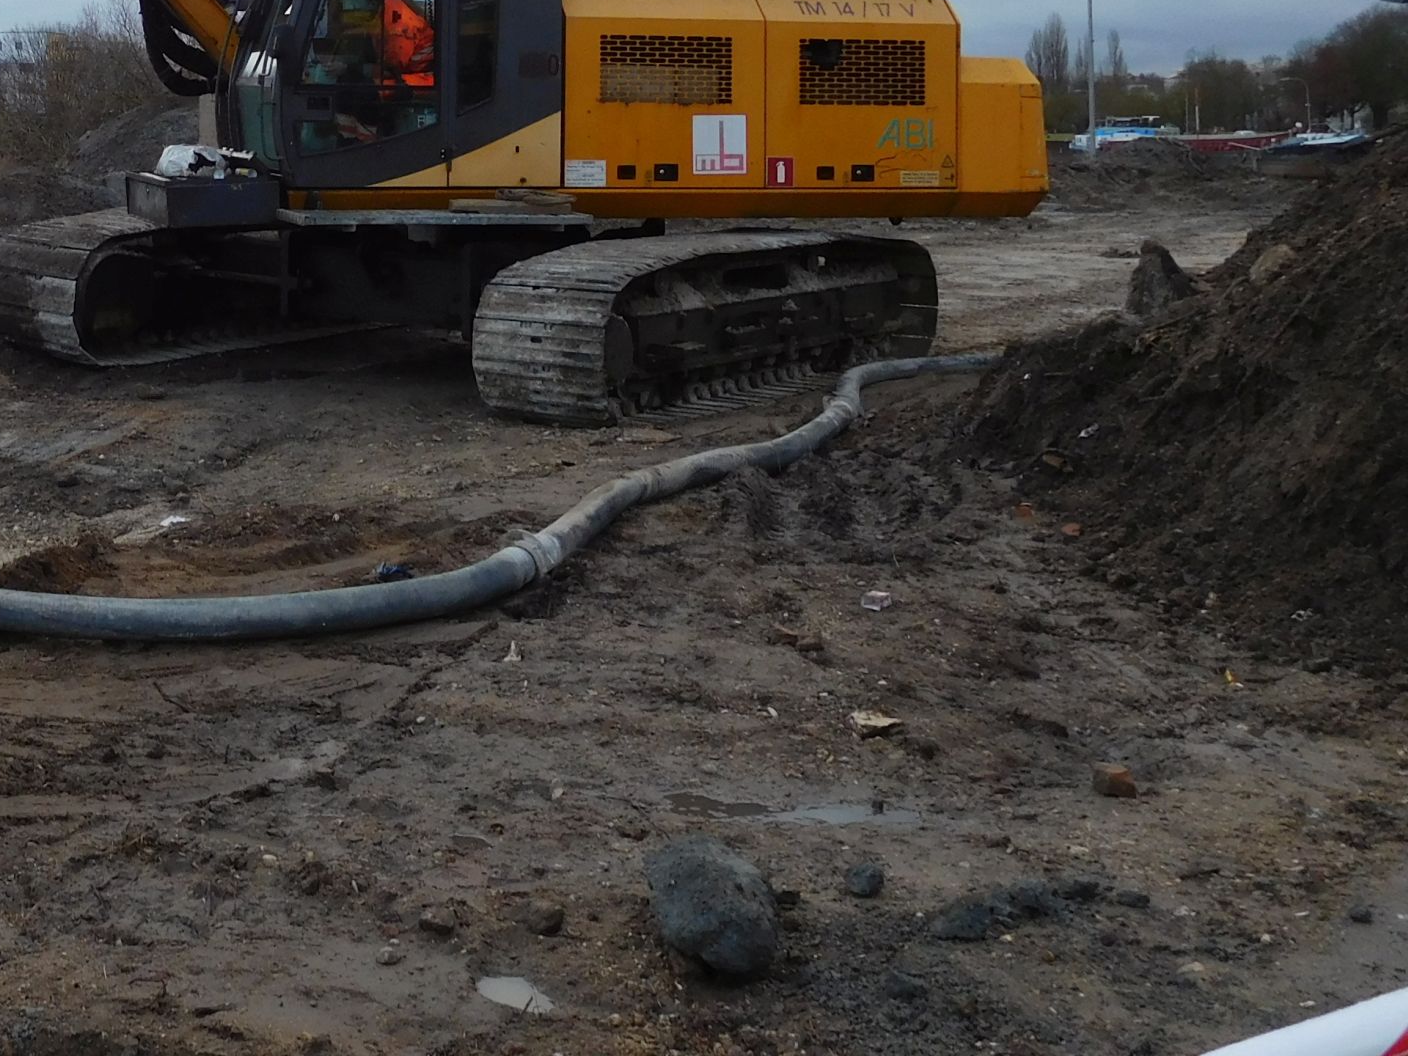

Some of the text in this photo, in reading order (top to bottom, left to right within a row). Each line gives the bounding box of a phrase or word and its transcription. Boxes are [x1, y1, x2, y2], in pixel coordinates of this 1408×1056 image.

[793, 0, 827, 16] TM
[832, 1, 854, 17] 14
[873, 2, 890, 17] 17
[898, 2, 914, 17] V
[876, 118, 934, 150] ABI
